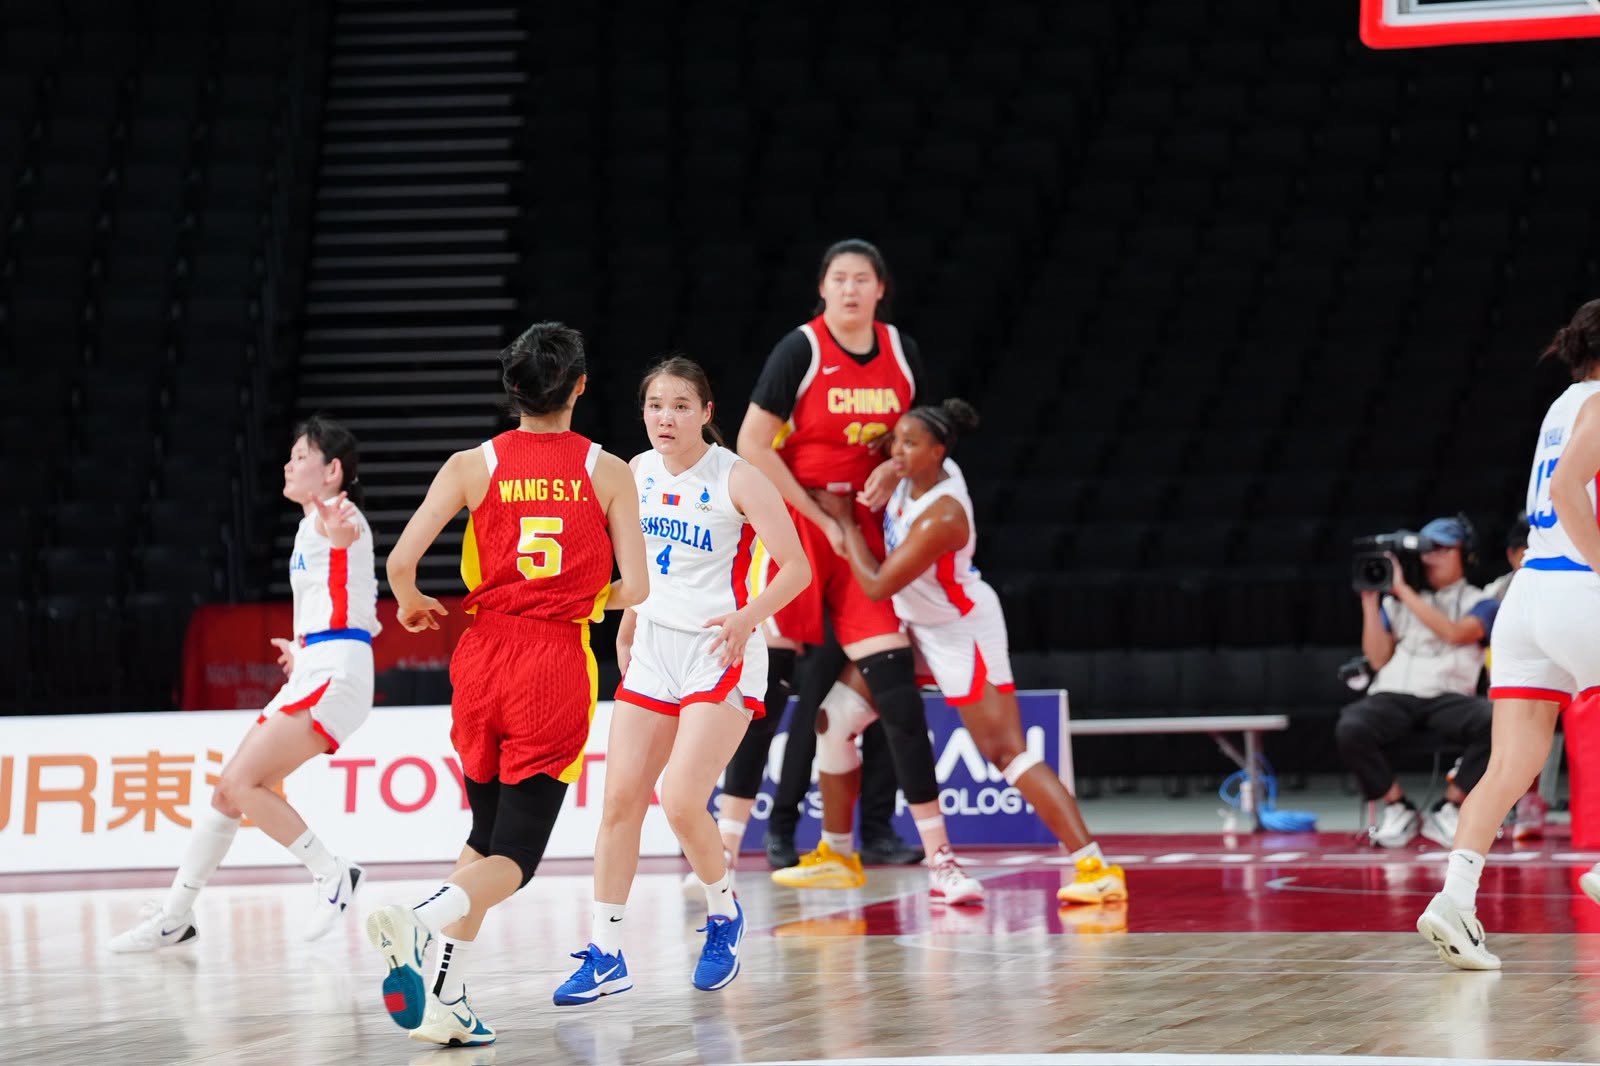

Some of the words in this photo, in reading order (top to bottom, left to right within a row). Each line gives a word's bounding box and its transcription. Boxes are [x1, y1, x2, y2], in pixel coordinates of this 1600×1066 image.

[828, 387, 901, 414] CHINA
[498, 478, 548, 503] WANG
[552, 479, 588, 501] S.Y.
[516, 516, 564, 580] 5
[656, 544, 672, 575] 4
[0, 748, 287, 835] JR東
